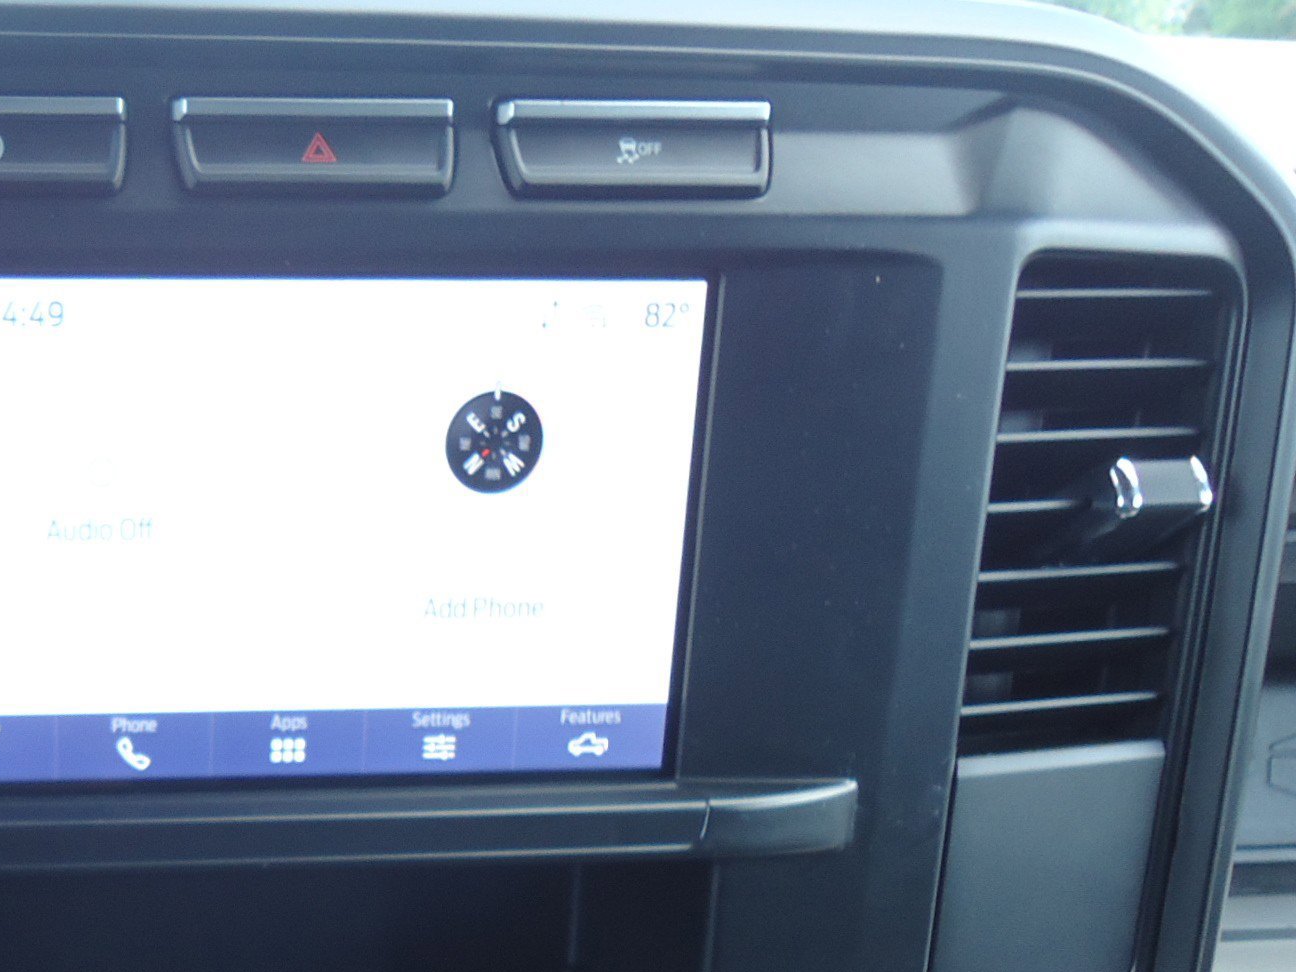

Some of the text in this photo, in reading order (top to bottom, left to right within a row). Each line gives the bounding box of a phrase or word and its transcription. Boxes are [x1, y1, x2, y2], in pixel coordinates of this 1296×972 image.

[638, 142, 662, 156] OFF
[2, 300, 64, 327] 4:49
[506, 411, 526, 433] S
[47, 518, 153, 542] Audio Off
[424, 597, 544, 619] Add Phone
[110, 716, 158, 734] Phone
[271, 714, 307, 732] Apps
[412, 711, 471, 730] Settings
[560, 708, 622, 726] Features
